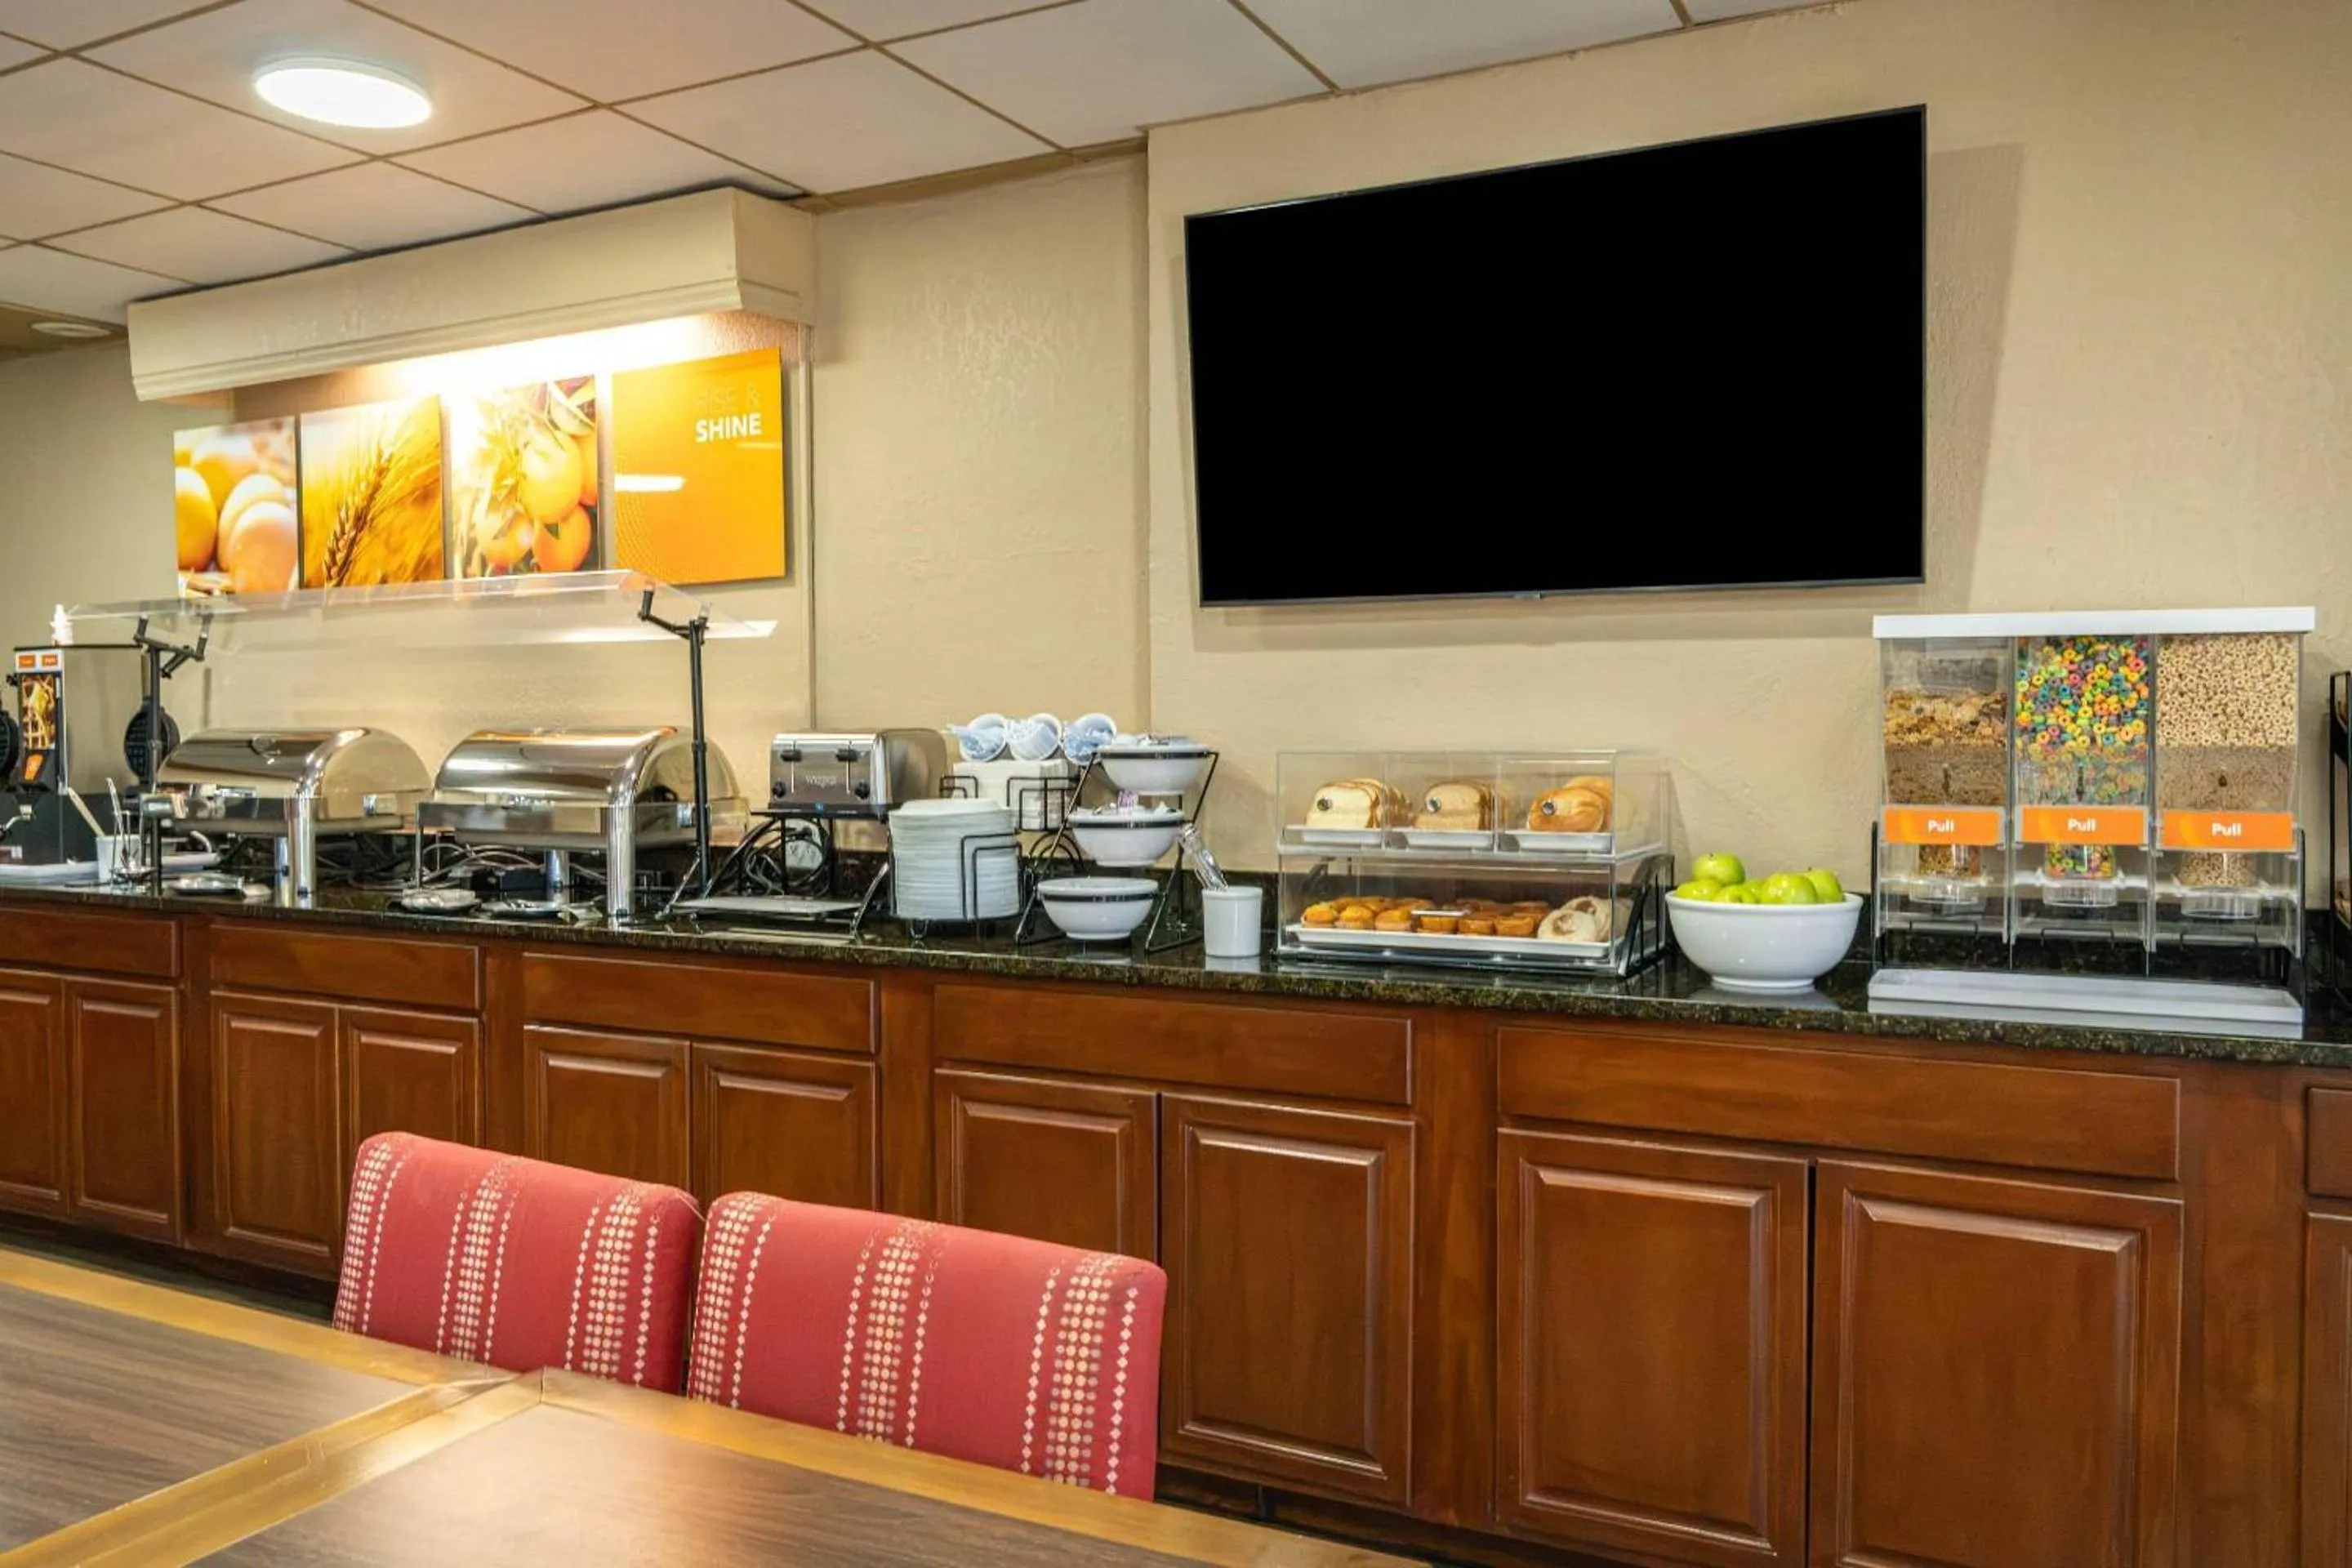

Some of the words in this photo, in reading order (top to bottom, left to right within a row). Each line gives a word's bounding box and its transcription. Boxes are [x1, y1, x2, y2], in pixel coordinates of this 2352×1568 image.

[696, 412, 762, 443] SHINE
[1927, 817, 1955, 833] Pull
[2067, 817, 2096, 832] Pull
[2212, 822, 2242, 836] Pull
